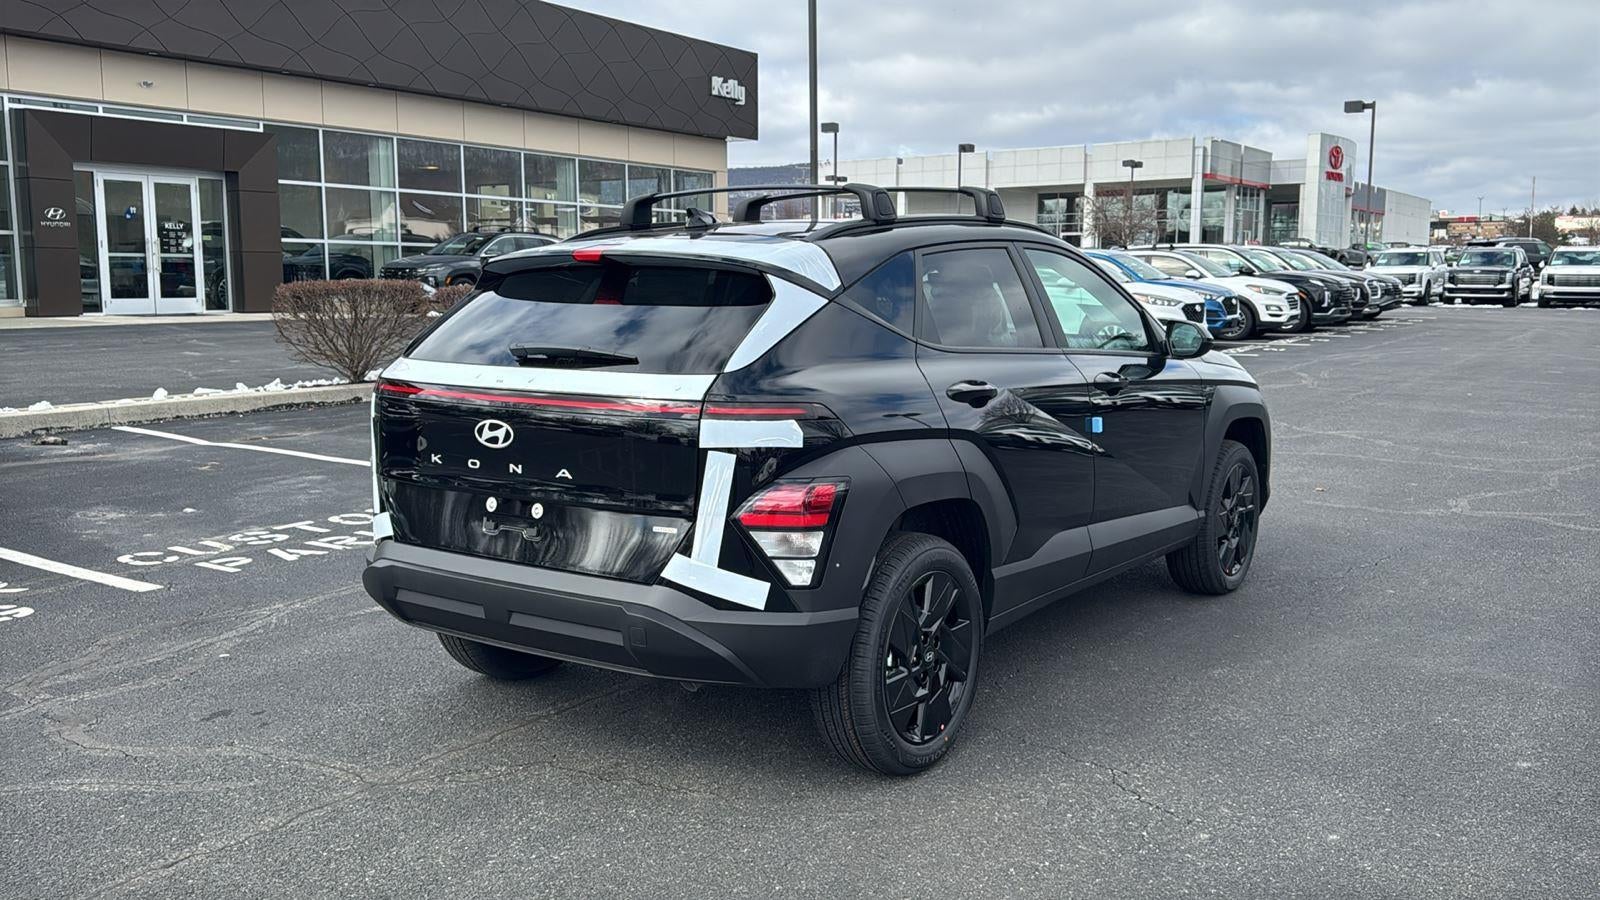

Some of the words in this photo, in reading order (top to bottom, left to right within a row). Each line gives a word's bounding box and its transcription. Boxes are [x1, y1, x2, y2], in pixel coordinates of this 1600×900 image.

[711, 76, 746, 105] Kelly
[164, 222, 184, 230] KELLY
[431, 453, 573, 480] KONA
[117, 508, 374, 566] CUSTO
